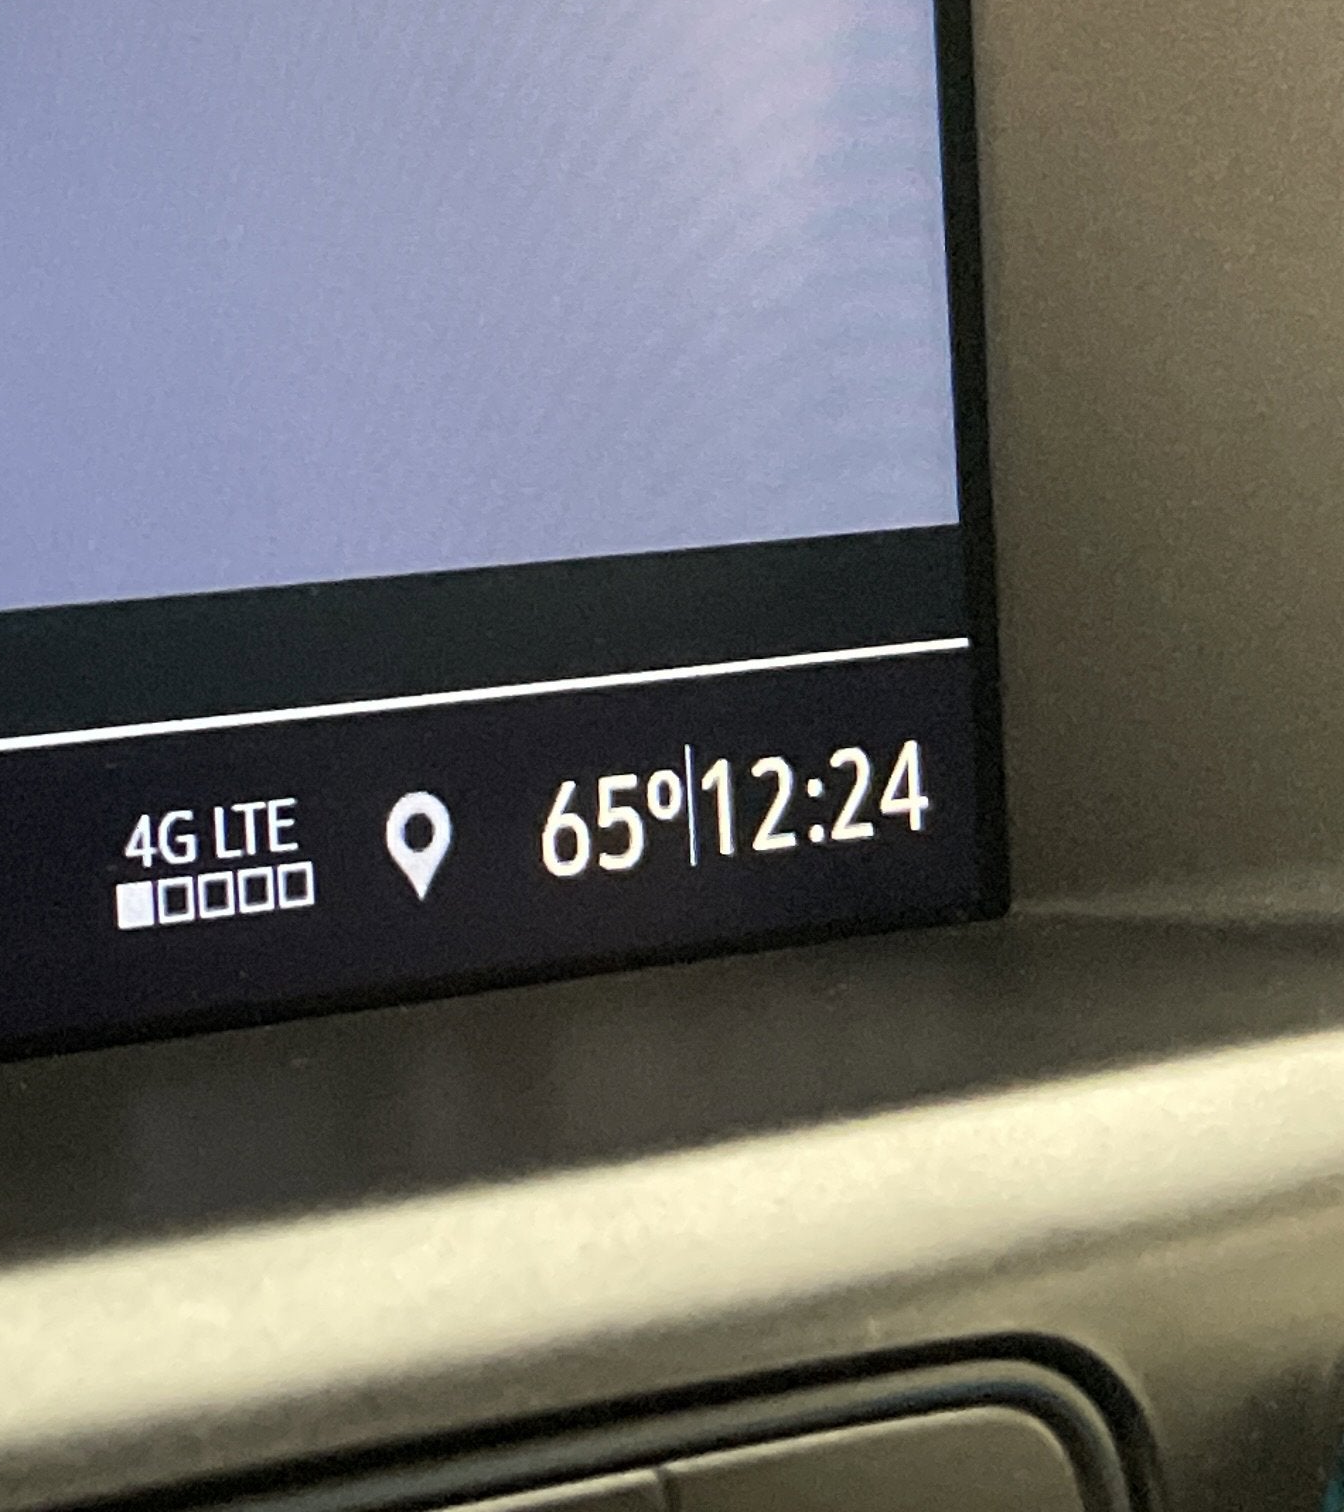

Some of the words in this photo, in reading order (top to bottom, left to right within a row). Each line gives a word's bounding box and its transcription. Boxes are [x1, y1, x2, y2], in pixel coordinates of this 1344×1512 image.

[123, 808, 198, 869] 4G
[212, 796, 300, 860] LTE
[700, 738, 931, 857] 12:24
